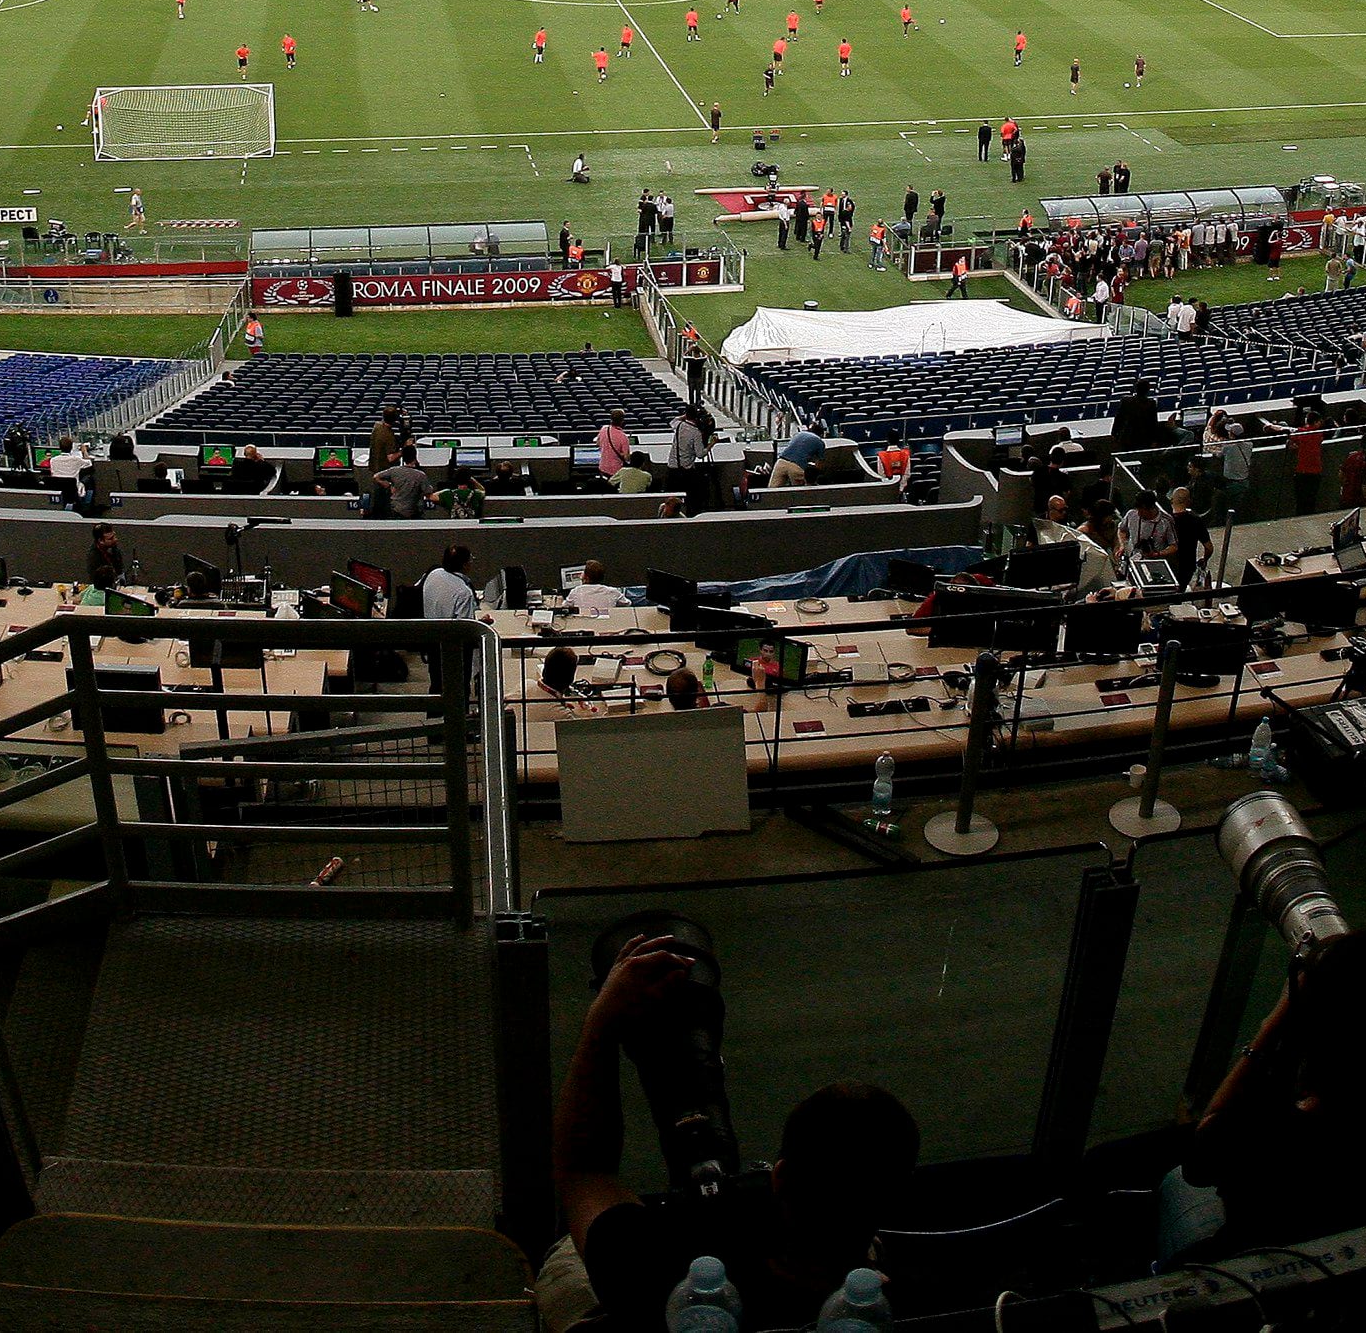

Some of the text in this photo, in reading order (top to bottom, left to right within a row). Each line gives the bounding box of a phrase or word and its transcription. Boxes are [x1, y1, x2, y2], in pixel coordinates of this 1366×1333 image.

[352, 277, 540, 298] ROMA FINALE 2009
